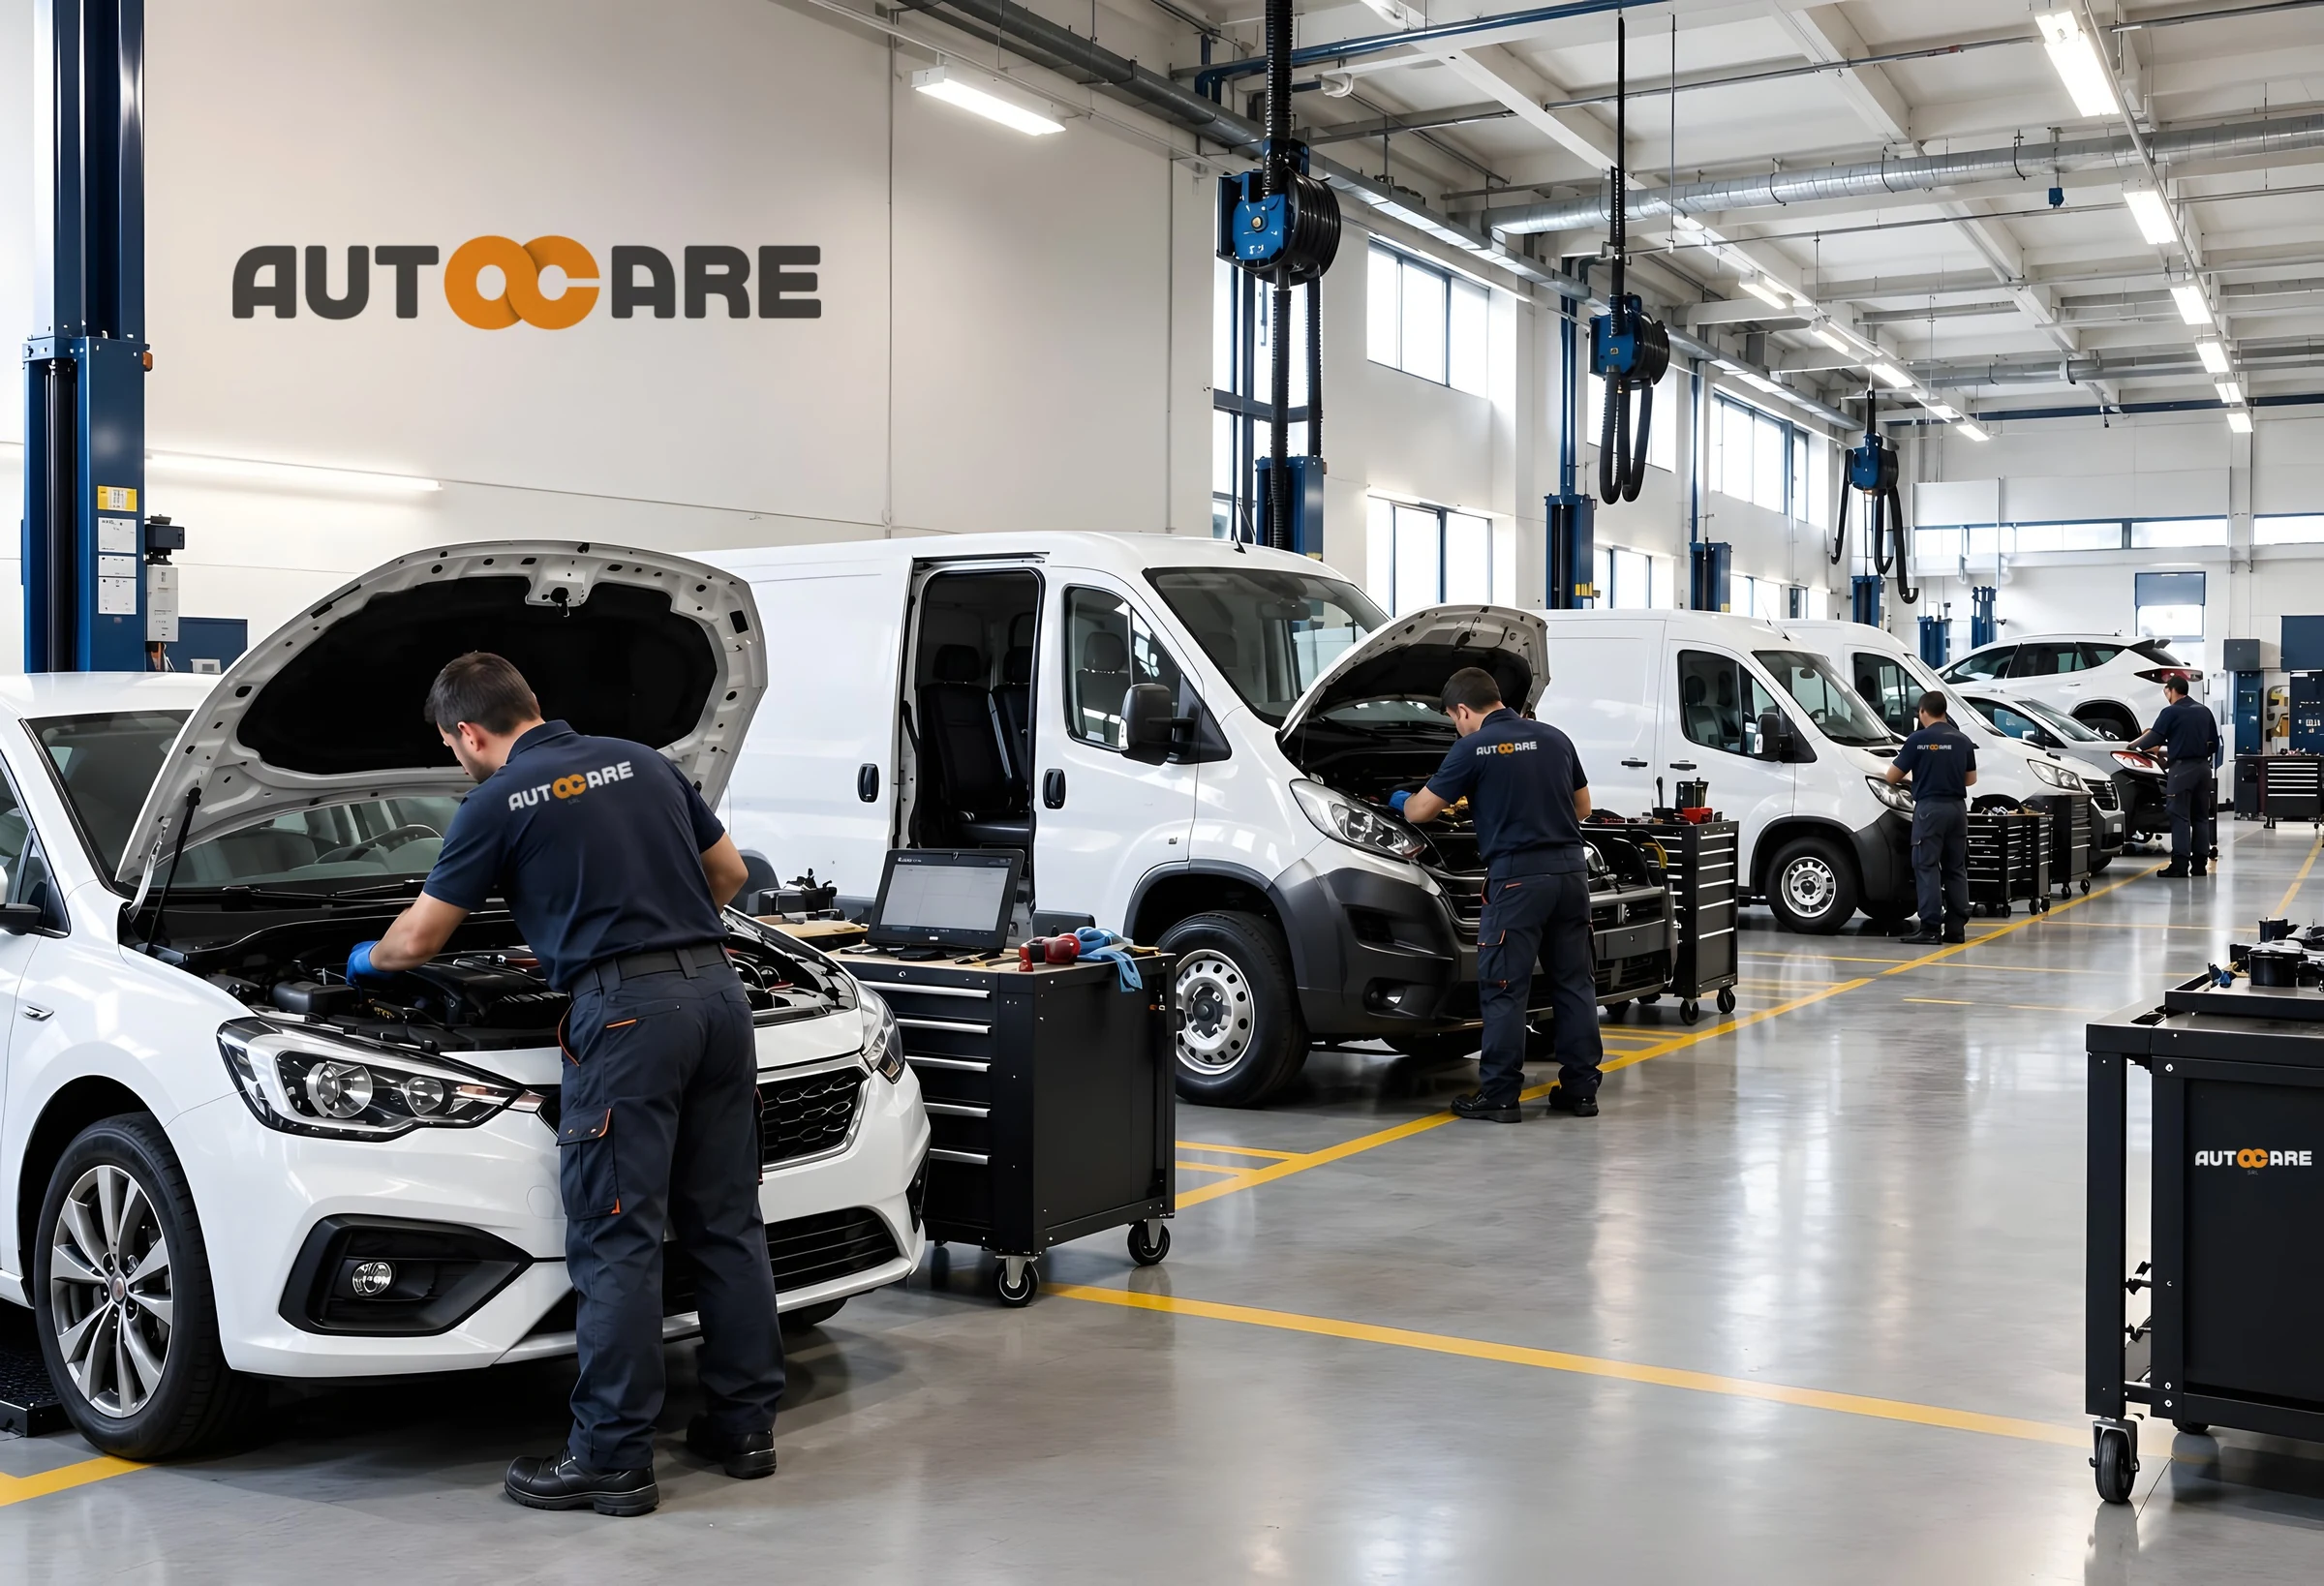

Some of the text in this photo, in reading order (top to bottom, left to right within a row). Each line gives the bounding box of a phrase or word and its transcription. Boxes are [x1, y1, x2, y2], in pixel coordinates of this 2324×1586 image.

[232, 235, 822, 330] AUTOCARE
[1477, 741, 1537, 755] AUTOCARE
[507, 760, 634, 811] AUTOCARE
[2195, 1148, 2311, 1168] AUTOCARE
